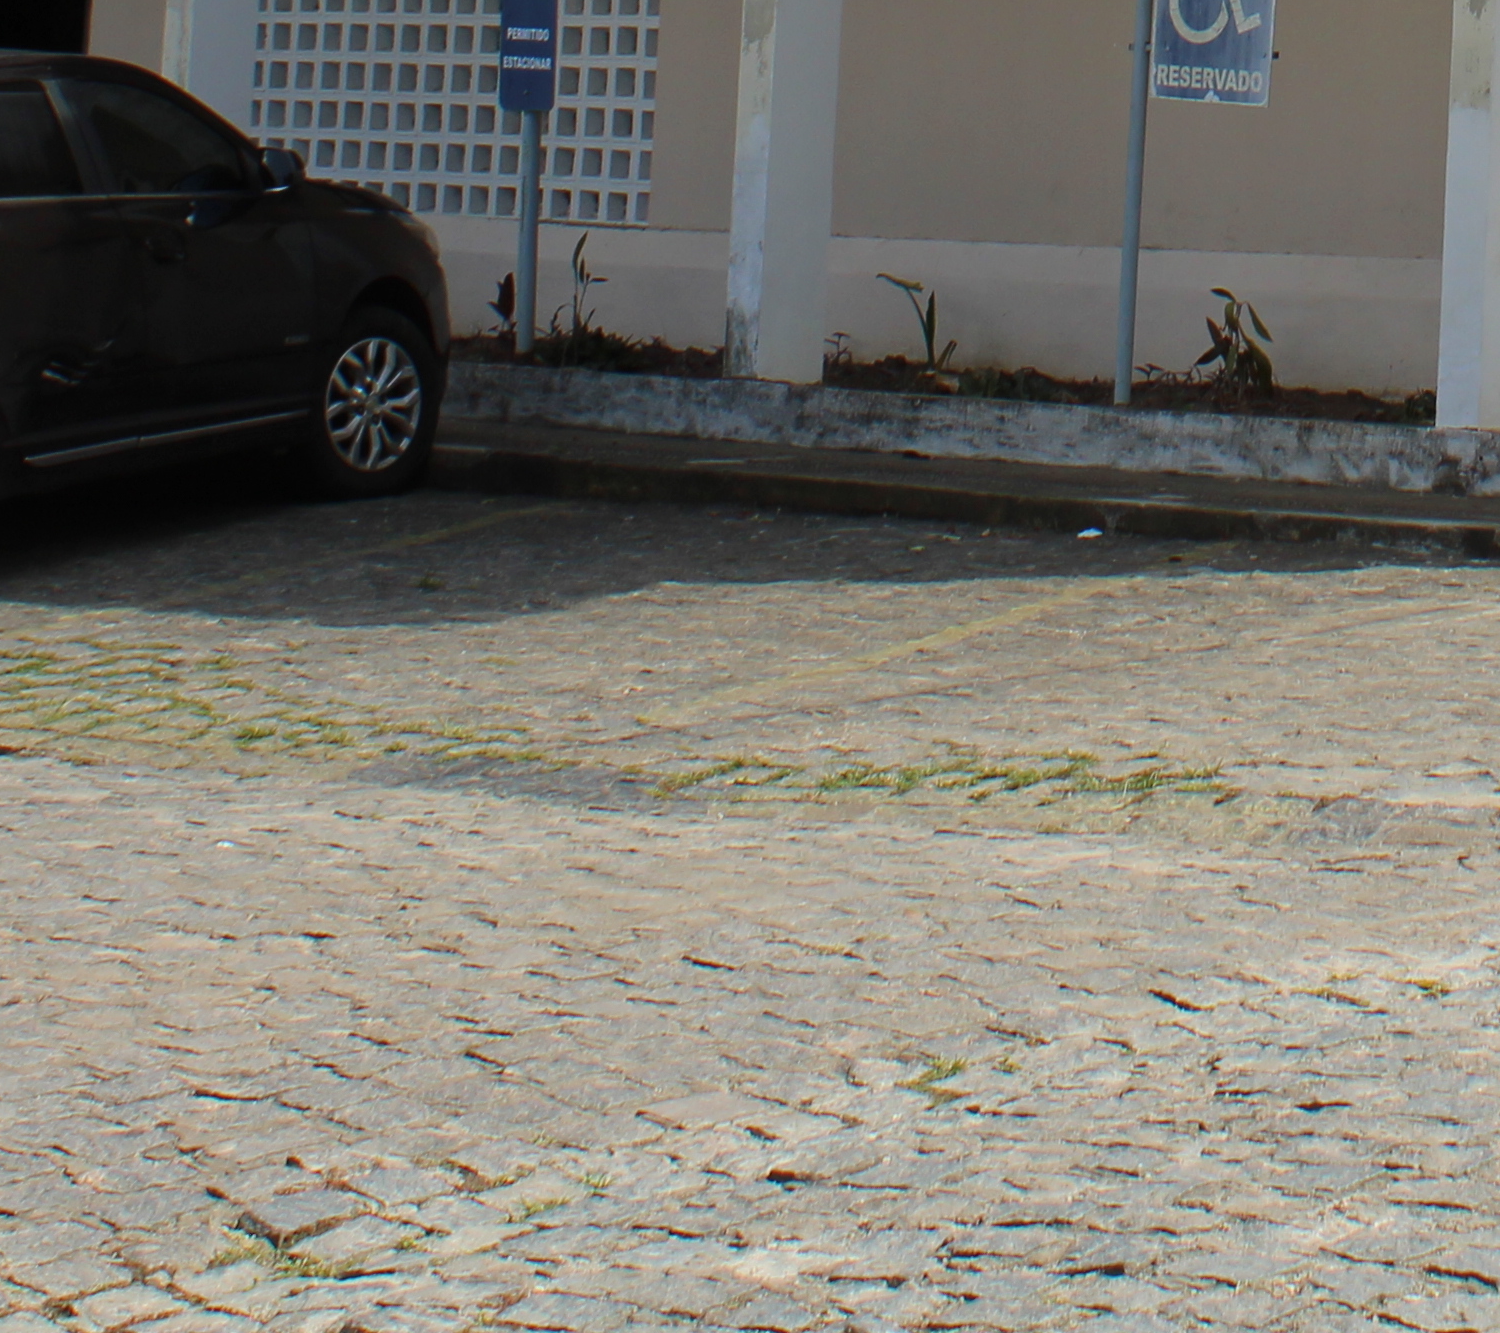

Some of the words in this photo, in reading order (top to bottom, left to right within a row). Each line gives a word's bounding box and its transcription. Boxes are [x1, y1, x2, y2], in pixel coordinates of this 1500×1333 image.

[506, 27, 550, 41] PERMITIDO
[503, 55, 552, 70] ESTACIONAR
[1156, 64, 1263, 92] RESERVADO
